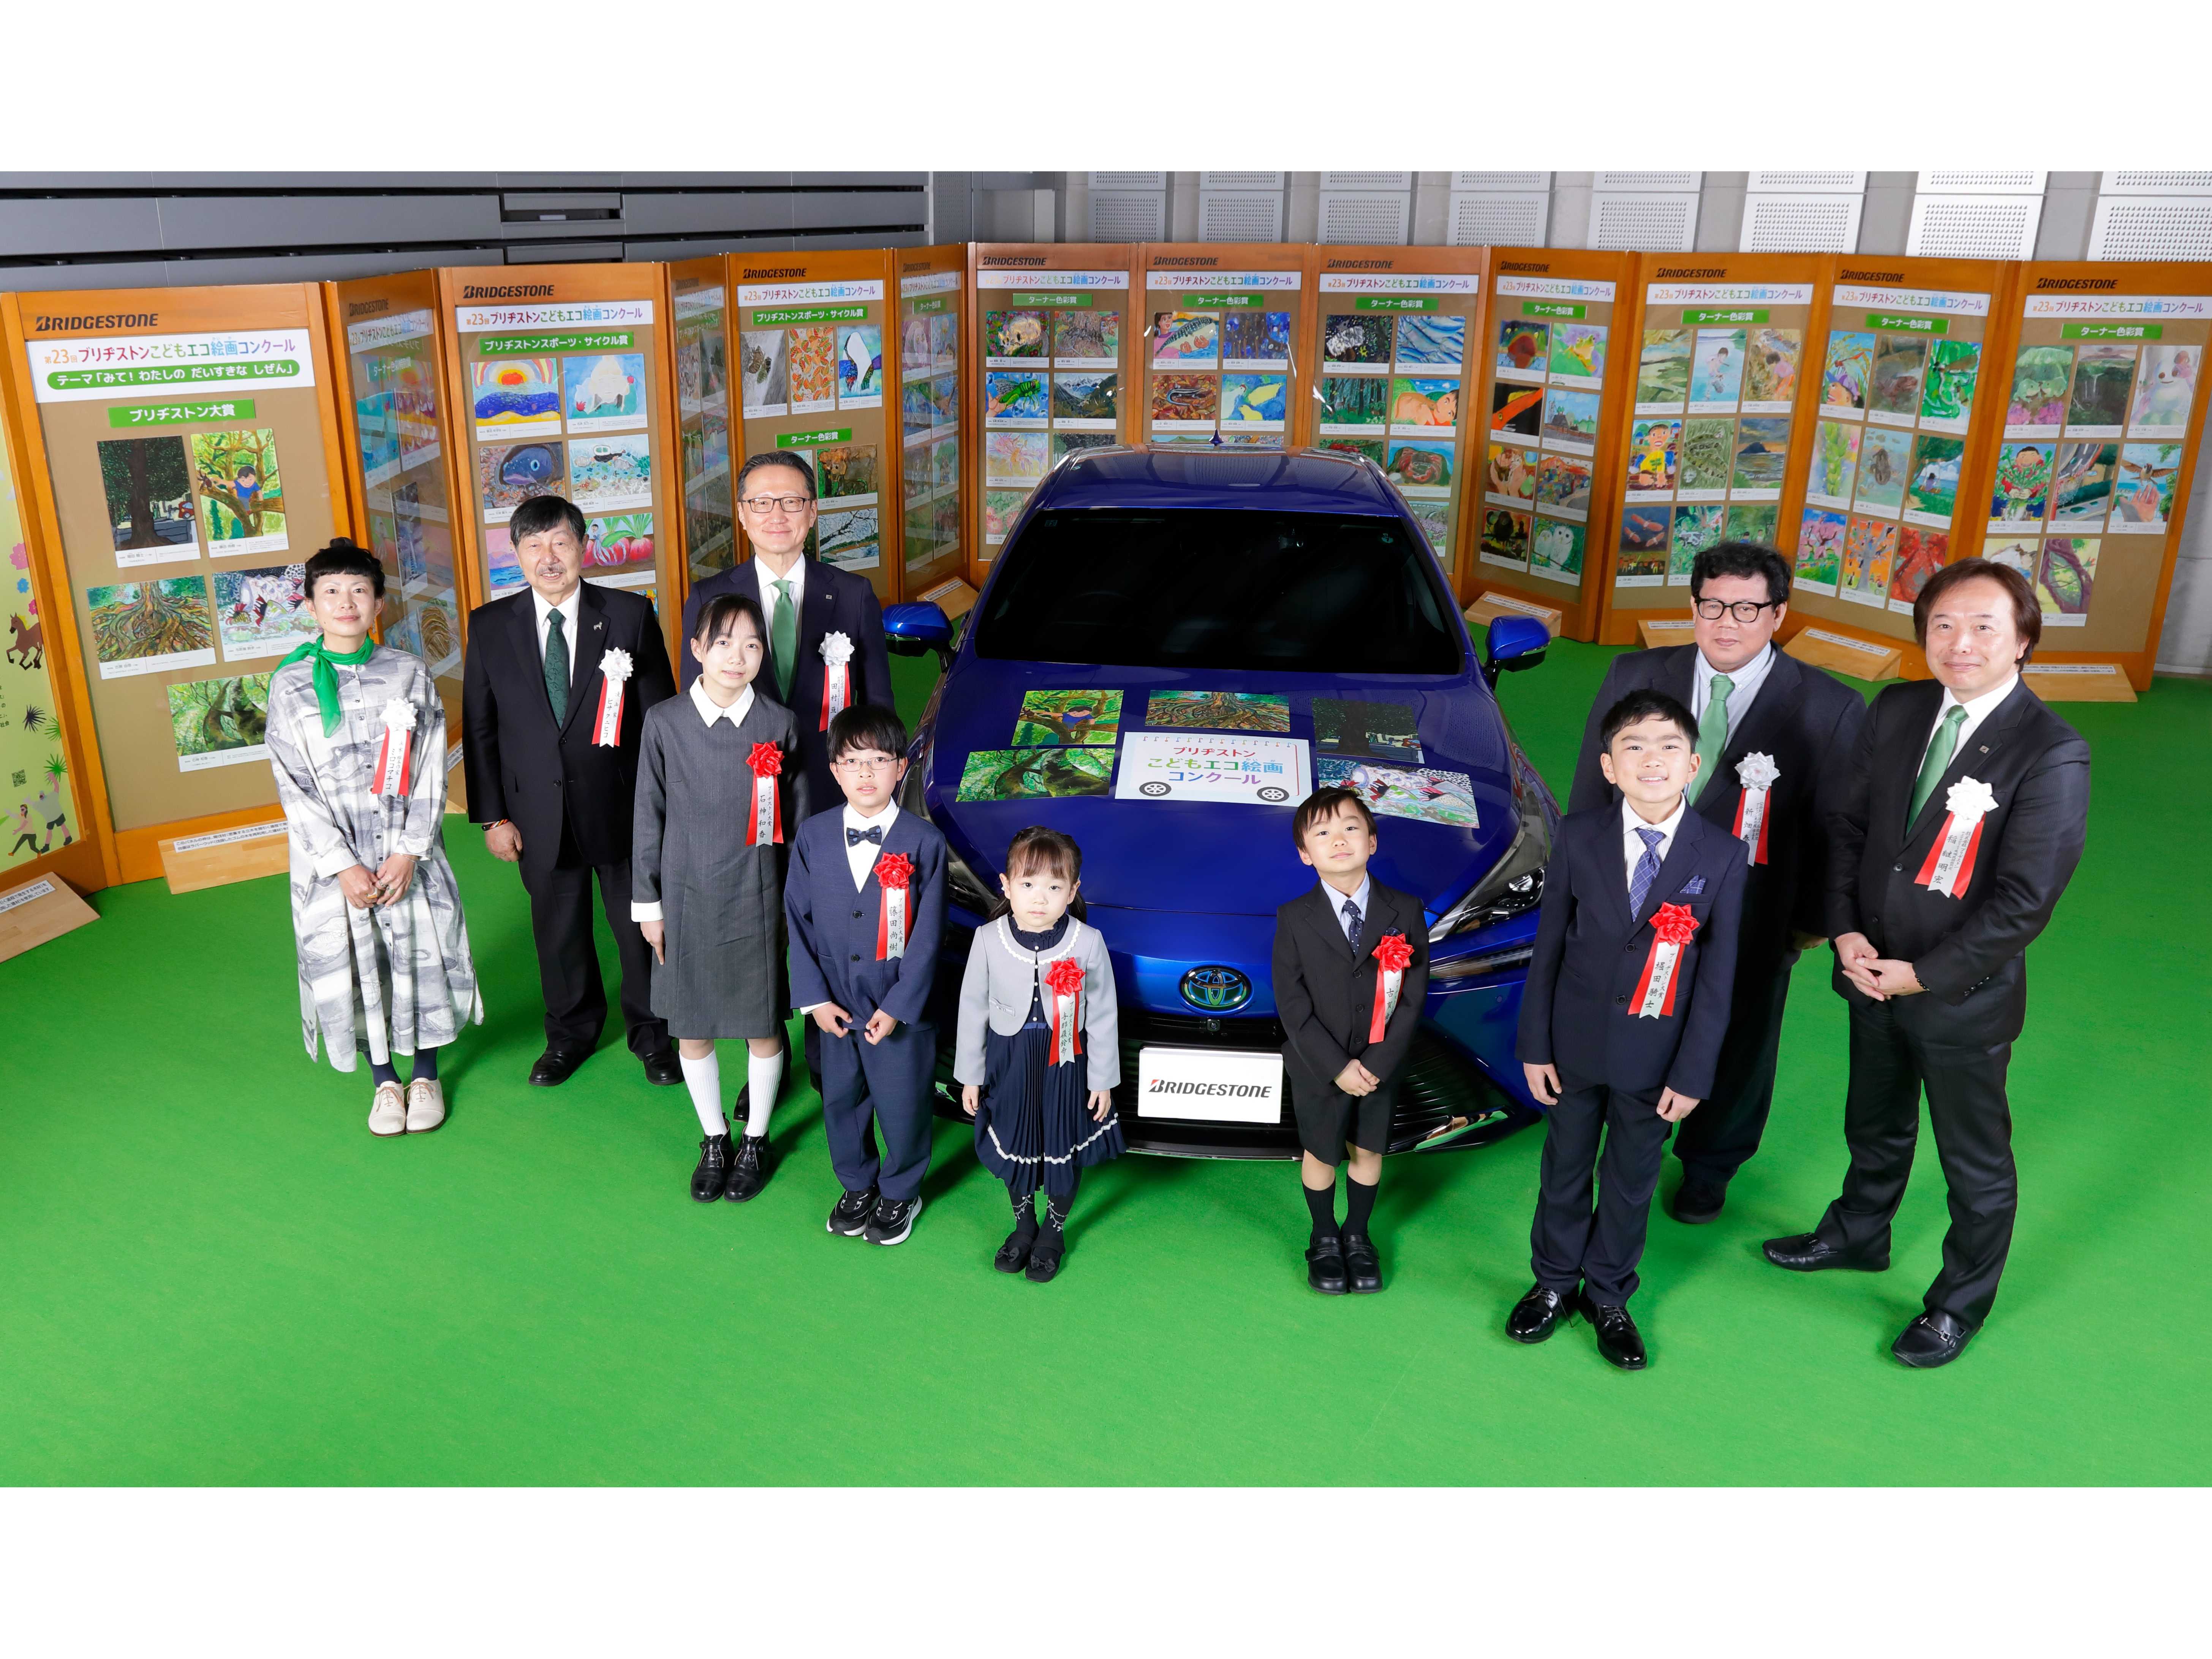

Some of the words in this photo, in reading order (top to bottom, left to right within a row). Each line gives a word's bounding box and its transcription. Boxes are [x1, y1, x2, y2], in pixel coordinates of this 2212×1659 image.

[982, 256, 1047, 266] BRIDGESTONE
[1153, 256, 1218, 266] BRIDGESTONE
[1327, 259, 1394, 269] BRIDGESTONE
[1500, 261, 1549, 273] BRIDGESTONE
[743, 268, 806, 278] BRIDGESTONE
[1656, 268, 1727, 278] BRIDGESTONE
[1840, 269, 1905, 282] BRIDGESTONE
[2036, 278, 2118, 289] BRIDGESTONE
[463, 285, 554, 299] BRIDGESTONE
[1029, 296, 1077, 305] ターナー色彩賞
[1197, 297, 1248, 305] ターナー色彩賞
[1371, 299, 1423, 308] ターナー色彩賞
[349, 299, 389, 316] BRIDGESTONE
[1534, 305, 1573, 316] ターナー色彩賞
[35, 313, 158, 331] BRIDGESTONE
[1699, 312, 1753, 322] ターナー色彩賞
[1881, 316, 1932, 330] ターナー色彩賞
[2080, 327, 2144, 337] ターナー色彩賞
[485, 335, 628, 352] ブリヂストンスポーツ・サイクル賞
[44, 338, 296, 365] 第23回ブリヂストンこどもエコ絵画コンクール
[139, 369, 185, 381] わたしの
[191, 367, 248, 379] だいすきな
[130, 404, 235, 422] ブリヂストン大賞
[791, 432, 839, 444] ターナー色彩賞
[604, 698, 613, 738] ヒサクニヒコ
[1173, 747, 1255, 757] ブリヂストン
[385, 748, 396, 790] ミロコマチコ
[1148, 758, 1283, 773] こどもエコ絵画
[1168, 772, 1262, 784] コンクール
[889, 906, 898, 951] 藤田尚樹
[1645, 962, 1665, 1008] 堀田騎士
[1148, 1079, 1272, 1098] BRIDGESTONE
